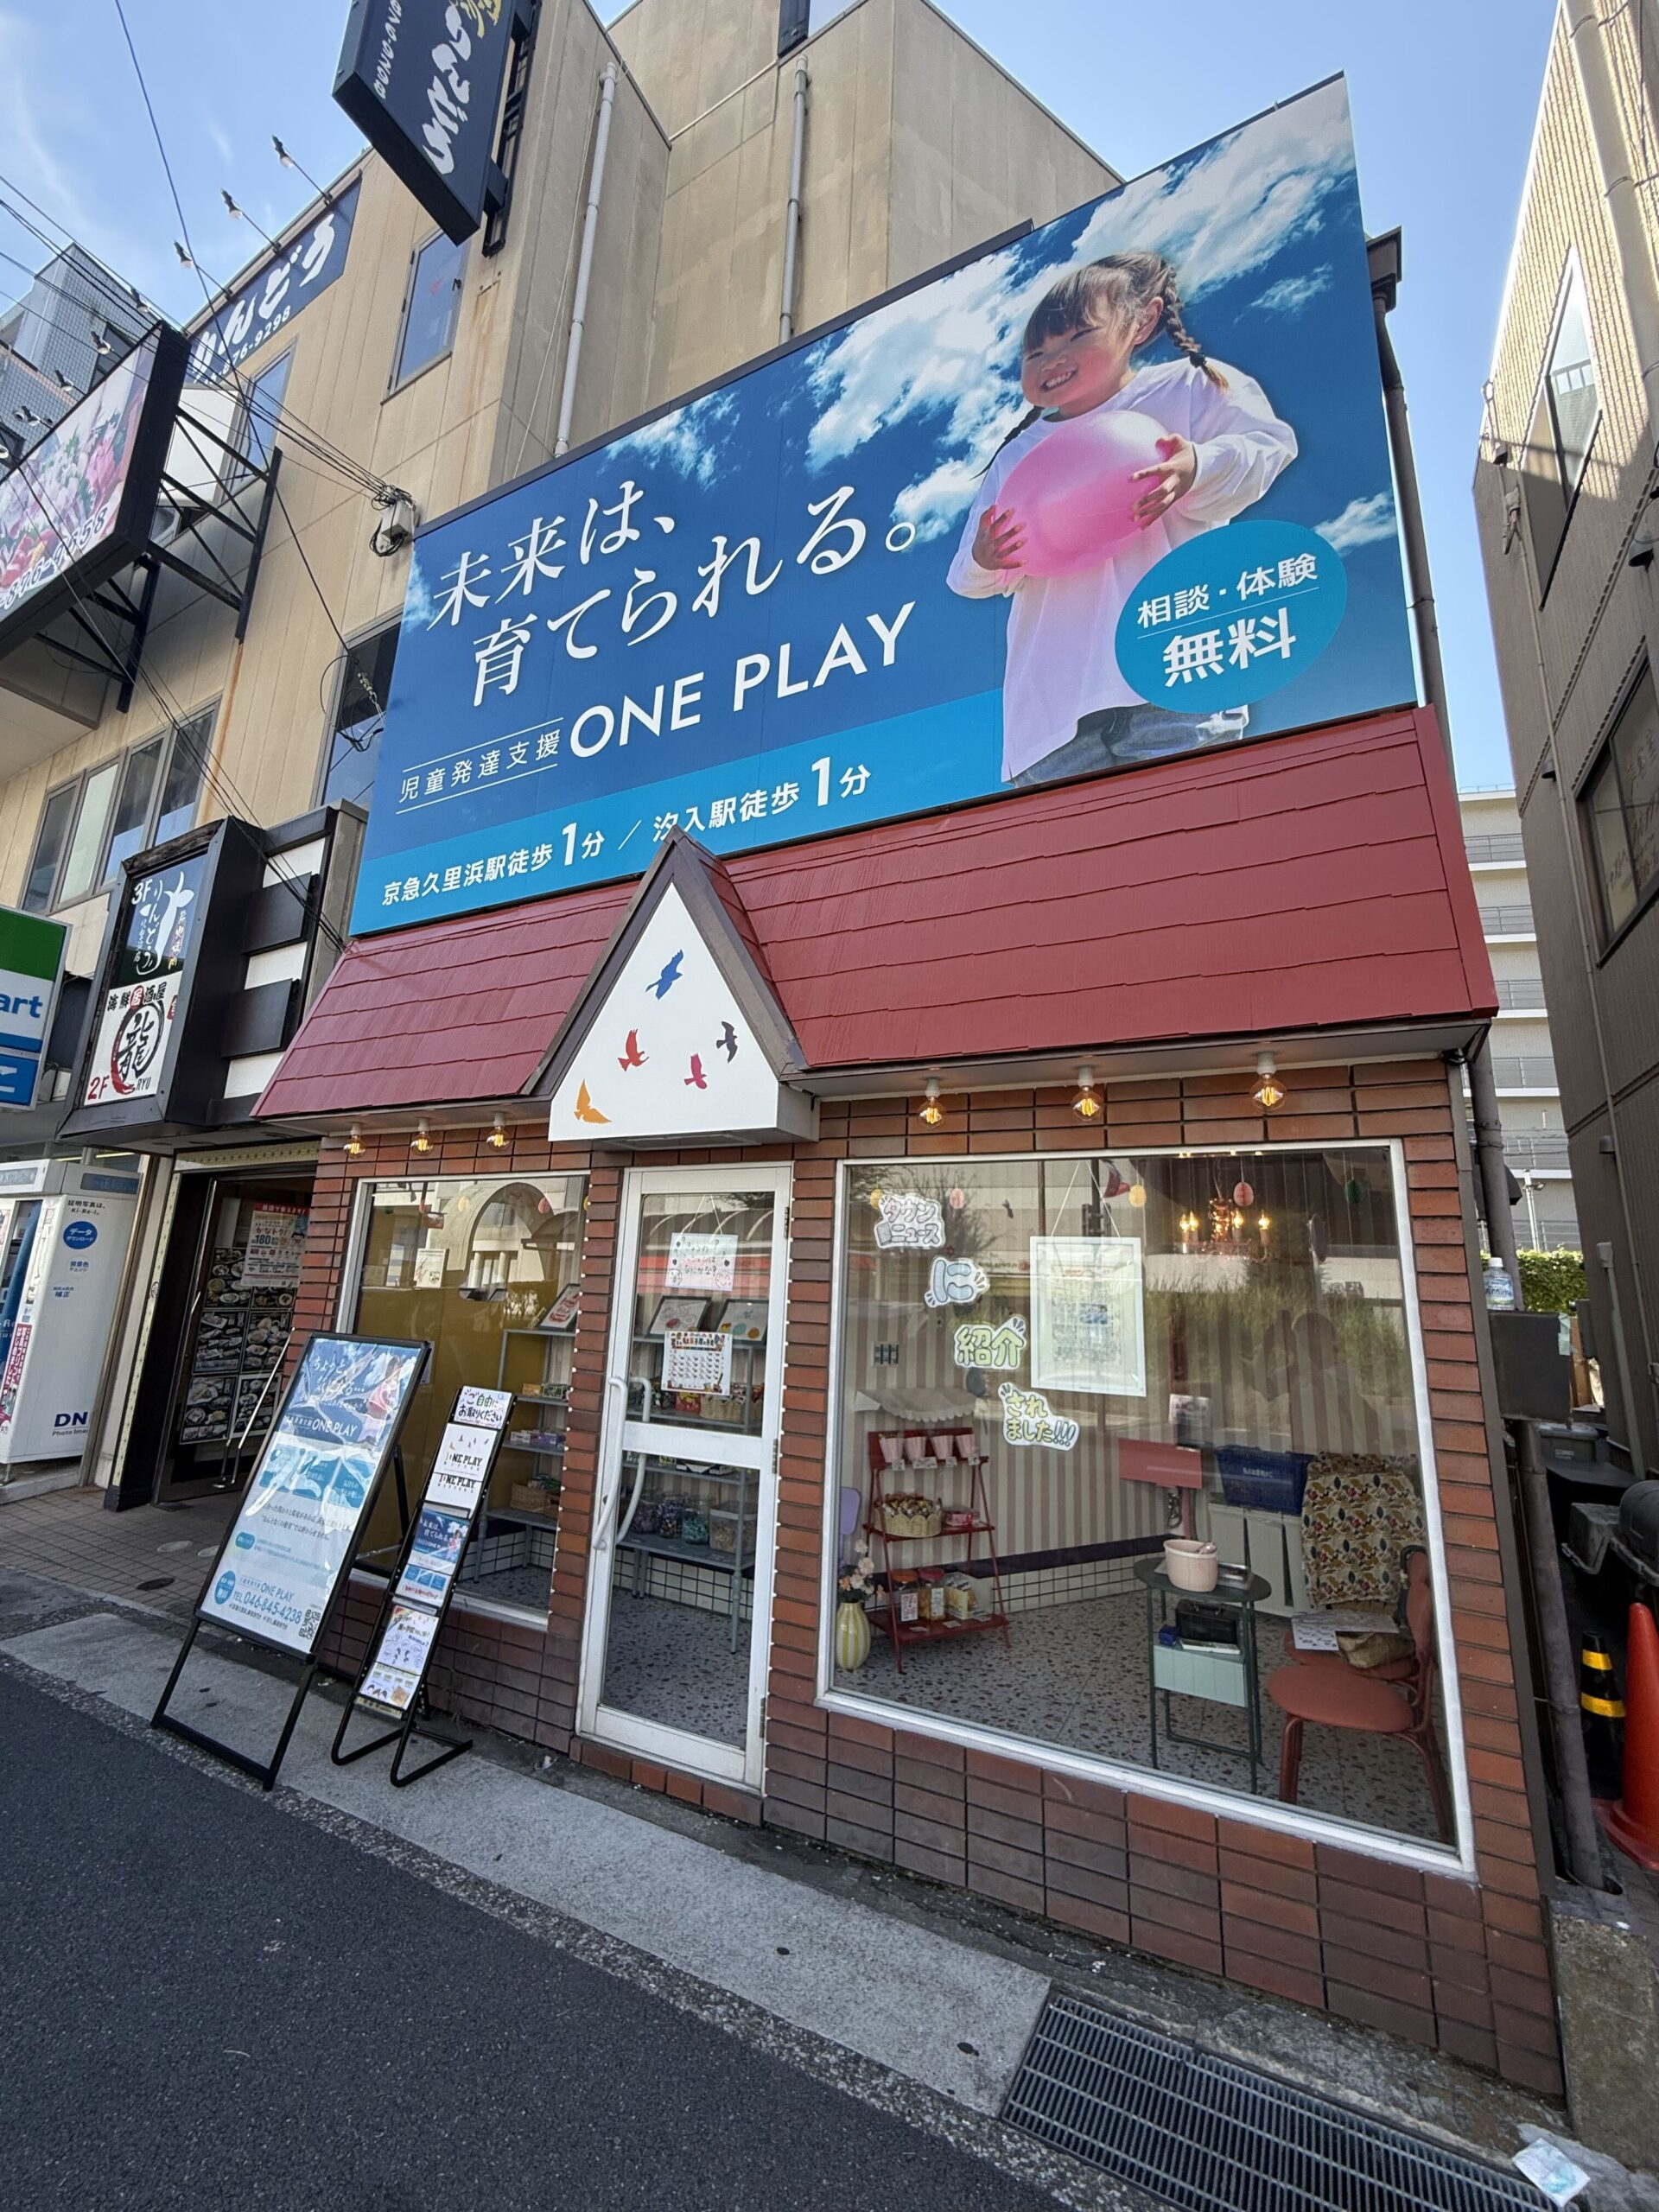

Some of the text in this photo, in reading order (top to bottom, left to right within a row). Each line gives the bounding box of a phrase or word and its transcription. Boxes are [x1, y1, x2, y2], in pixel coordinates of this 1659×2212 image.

[426, 480, 676, 632] 未来は、
[473, 486, 916, 707] 育てられる。
[1137, 553, 1318, 628] 相談・体験
[1163, 607, 1296, 687] 無料
[570, 601, 916, 758] ONE PLAY
[398, 729, 560, 804] 児童発達支援
[131, 880, 151, 906] 3F
[107, 982, 168, 1012] 海鮮居酒屋
[118, 1011, 155, 1079] 龍
[87, 1075, 110, 1100] 2F
[136, 1077, 152, 1090] RYU
[882, 1198, 938, 1224] タウン
[890, 1223, 940, 1245] ニュース
[931, 1258, 975, 1304] に
[956, 1326, 1025, 1368] 紹介
[458, 1404, 503, 1422] お取りください
[1005, 1391, 1048, 1418] され
[312, 1418, 334, 1433] ONE
[334, 1422, 358, 1438] PLAY
[463, 1453, 483, 1467] PLAY
[457, 1476, 476, 1490] PLAY
[260, 1581, 276, 1597] ONE
[276, 1587, 295, 1602] PLAY
[232, 1591, 243, 1604] TEL
[244, 1592, 302, 1624] 046-845-4238
